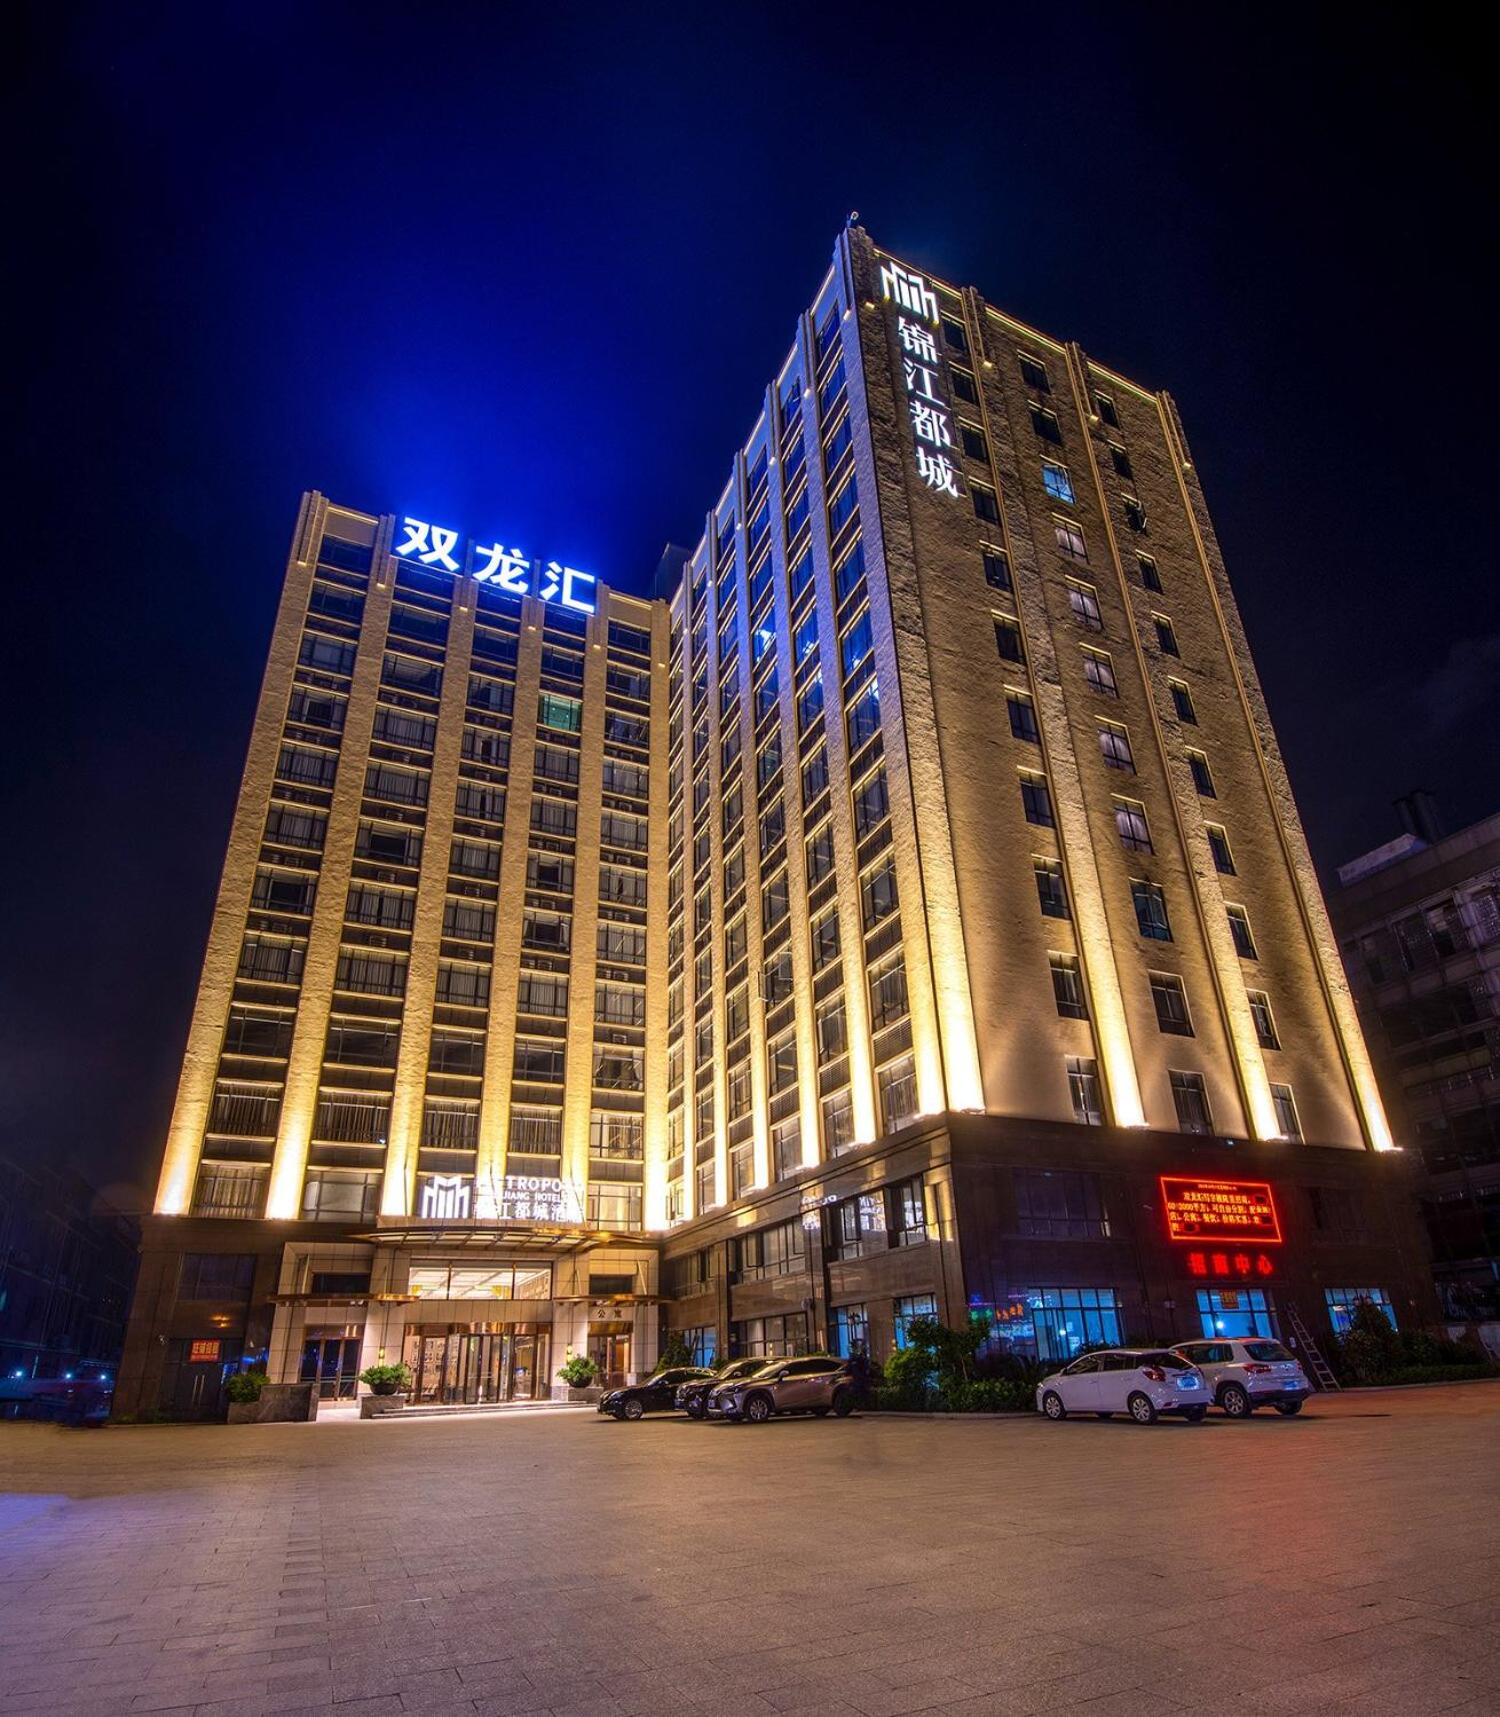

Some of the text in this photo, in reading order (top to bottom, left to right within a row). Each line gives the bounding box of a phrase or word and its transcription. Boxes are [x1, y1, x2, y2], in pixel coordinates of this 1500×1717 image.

[898, 315, 959, 499] 锦江都城
[395, 516, 596, 614] 双龙汇
